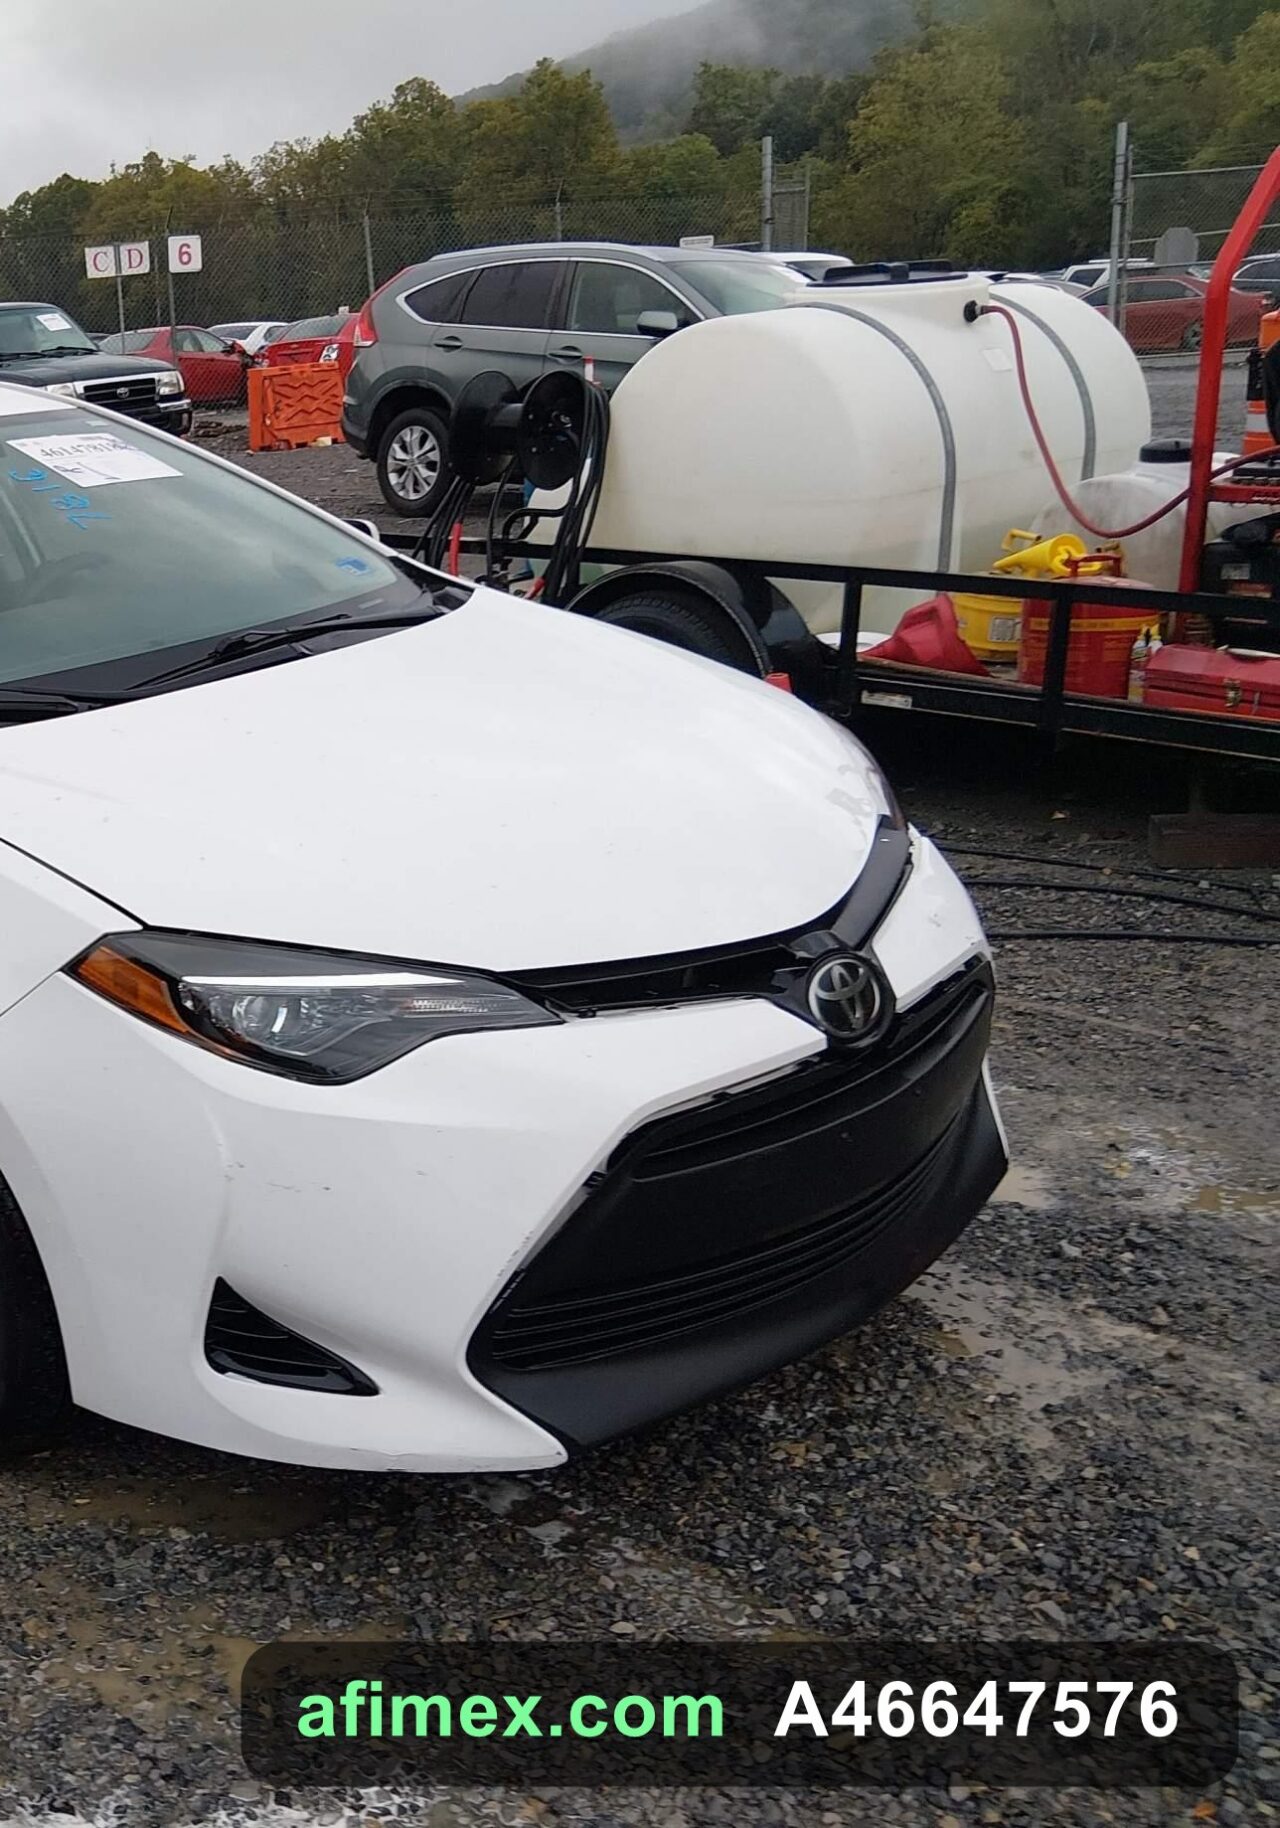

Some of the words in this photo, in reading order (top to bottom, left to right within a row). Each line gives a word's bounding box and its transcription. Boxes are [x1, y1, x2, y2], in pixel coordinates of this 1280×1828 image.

[93, 251, 109, 272] C
[126, 248, 143, 268] D
[178, 243, 192, 265] 6
